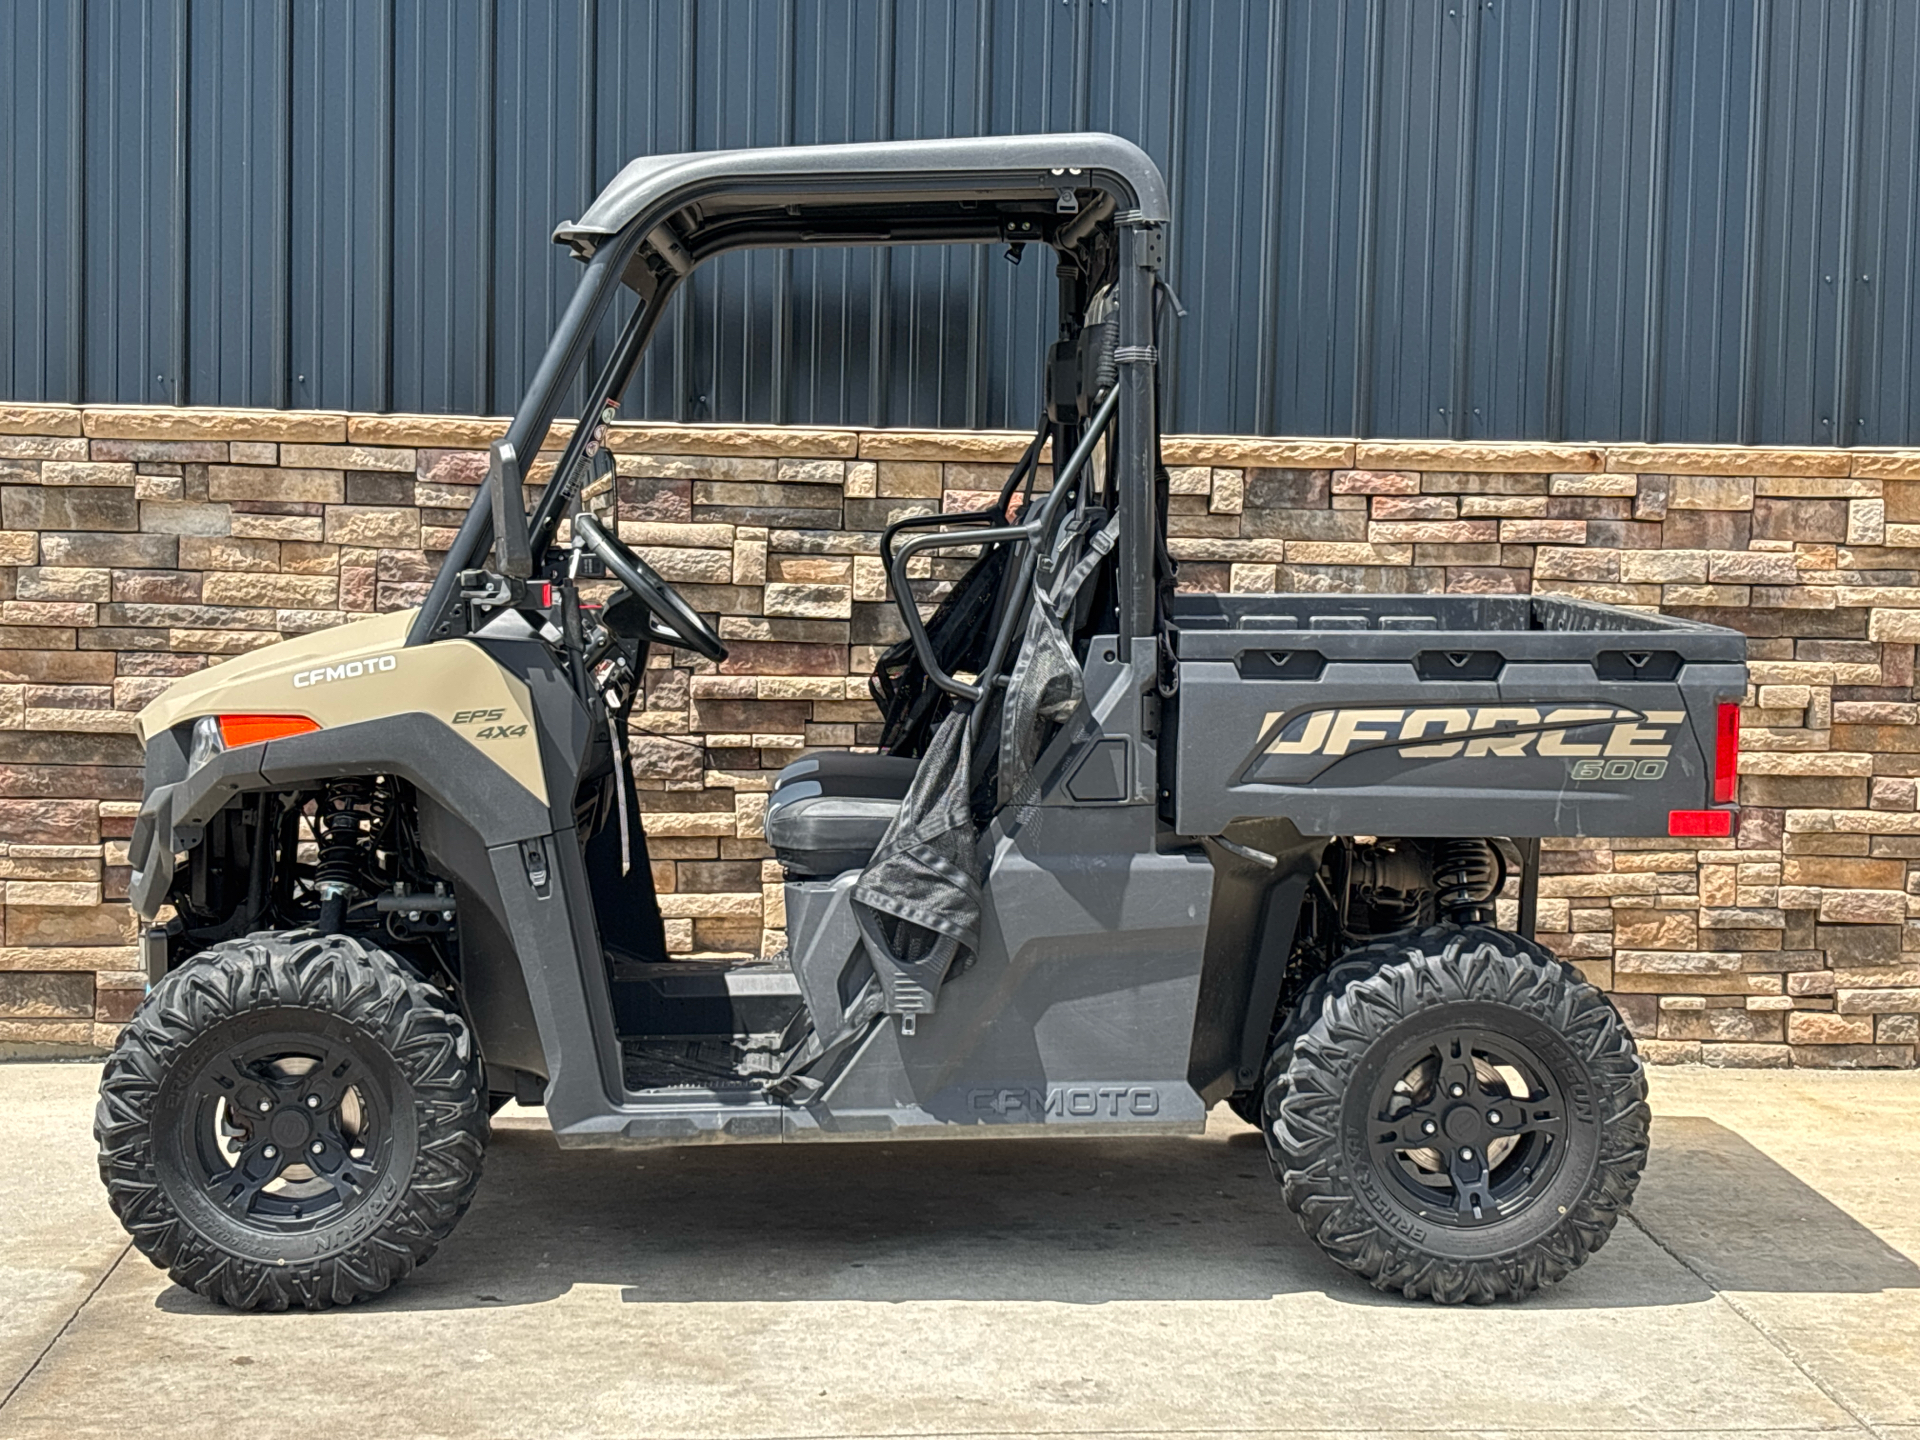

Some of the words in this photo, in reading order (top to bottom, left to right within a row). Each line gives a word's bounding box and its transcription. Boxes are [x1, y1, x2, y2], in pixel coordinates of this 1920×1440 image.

[293, 655, 396, 688] CFMOTO
[452, 708, 506, 724] EPS
[475, 724, 528, 739] 4X4
[1257, 708, 1686, 757] UFORCE
[1570, 759, 1669, 781] 600
[1523, 1031, 1594, 1125] ARISUN
[967, 1087, 1159, 1116] CFMOTO
[313, 1172, 397, 1254] ARISUN
[1358, 1169, 1427, 1244] BRUISER
